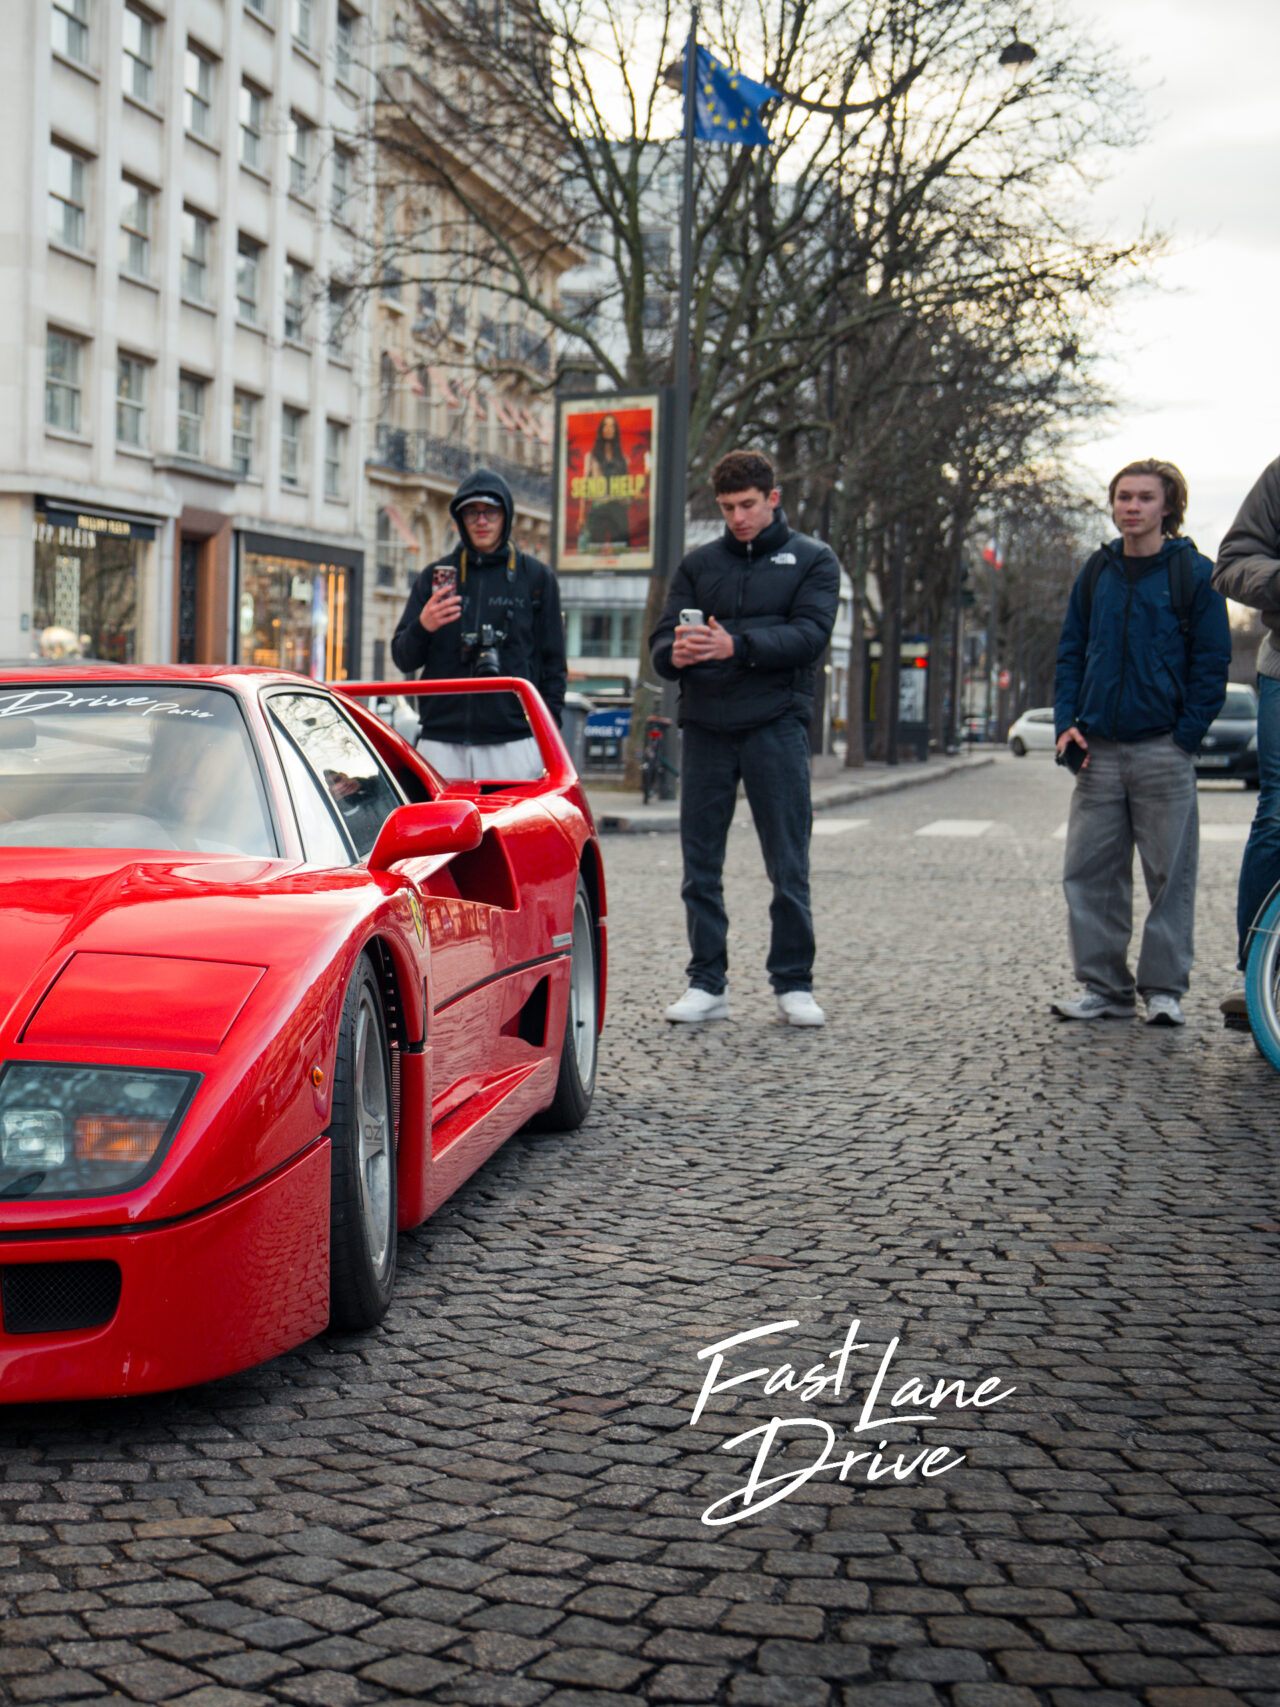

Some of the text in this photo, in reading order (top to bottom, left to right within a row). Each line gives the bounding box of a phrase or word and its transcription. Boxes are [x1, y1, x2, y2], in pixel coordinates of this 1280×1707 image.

[571, 473, 645, 498] SEND HELP
[141, 702, 215, 719] Paris
[364, 1124, 382, 1141] OZ
